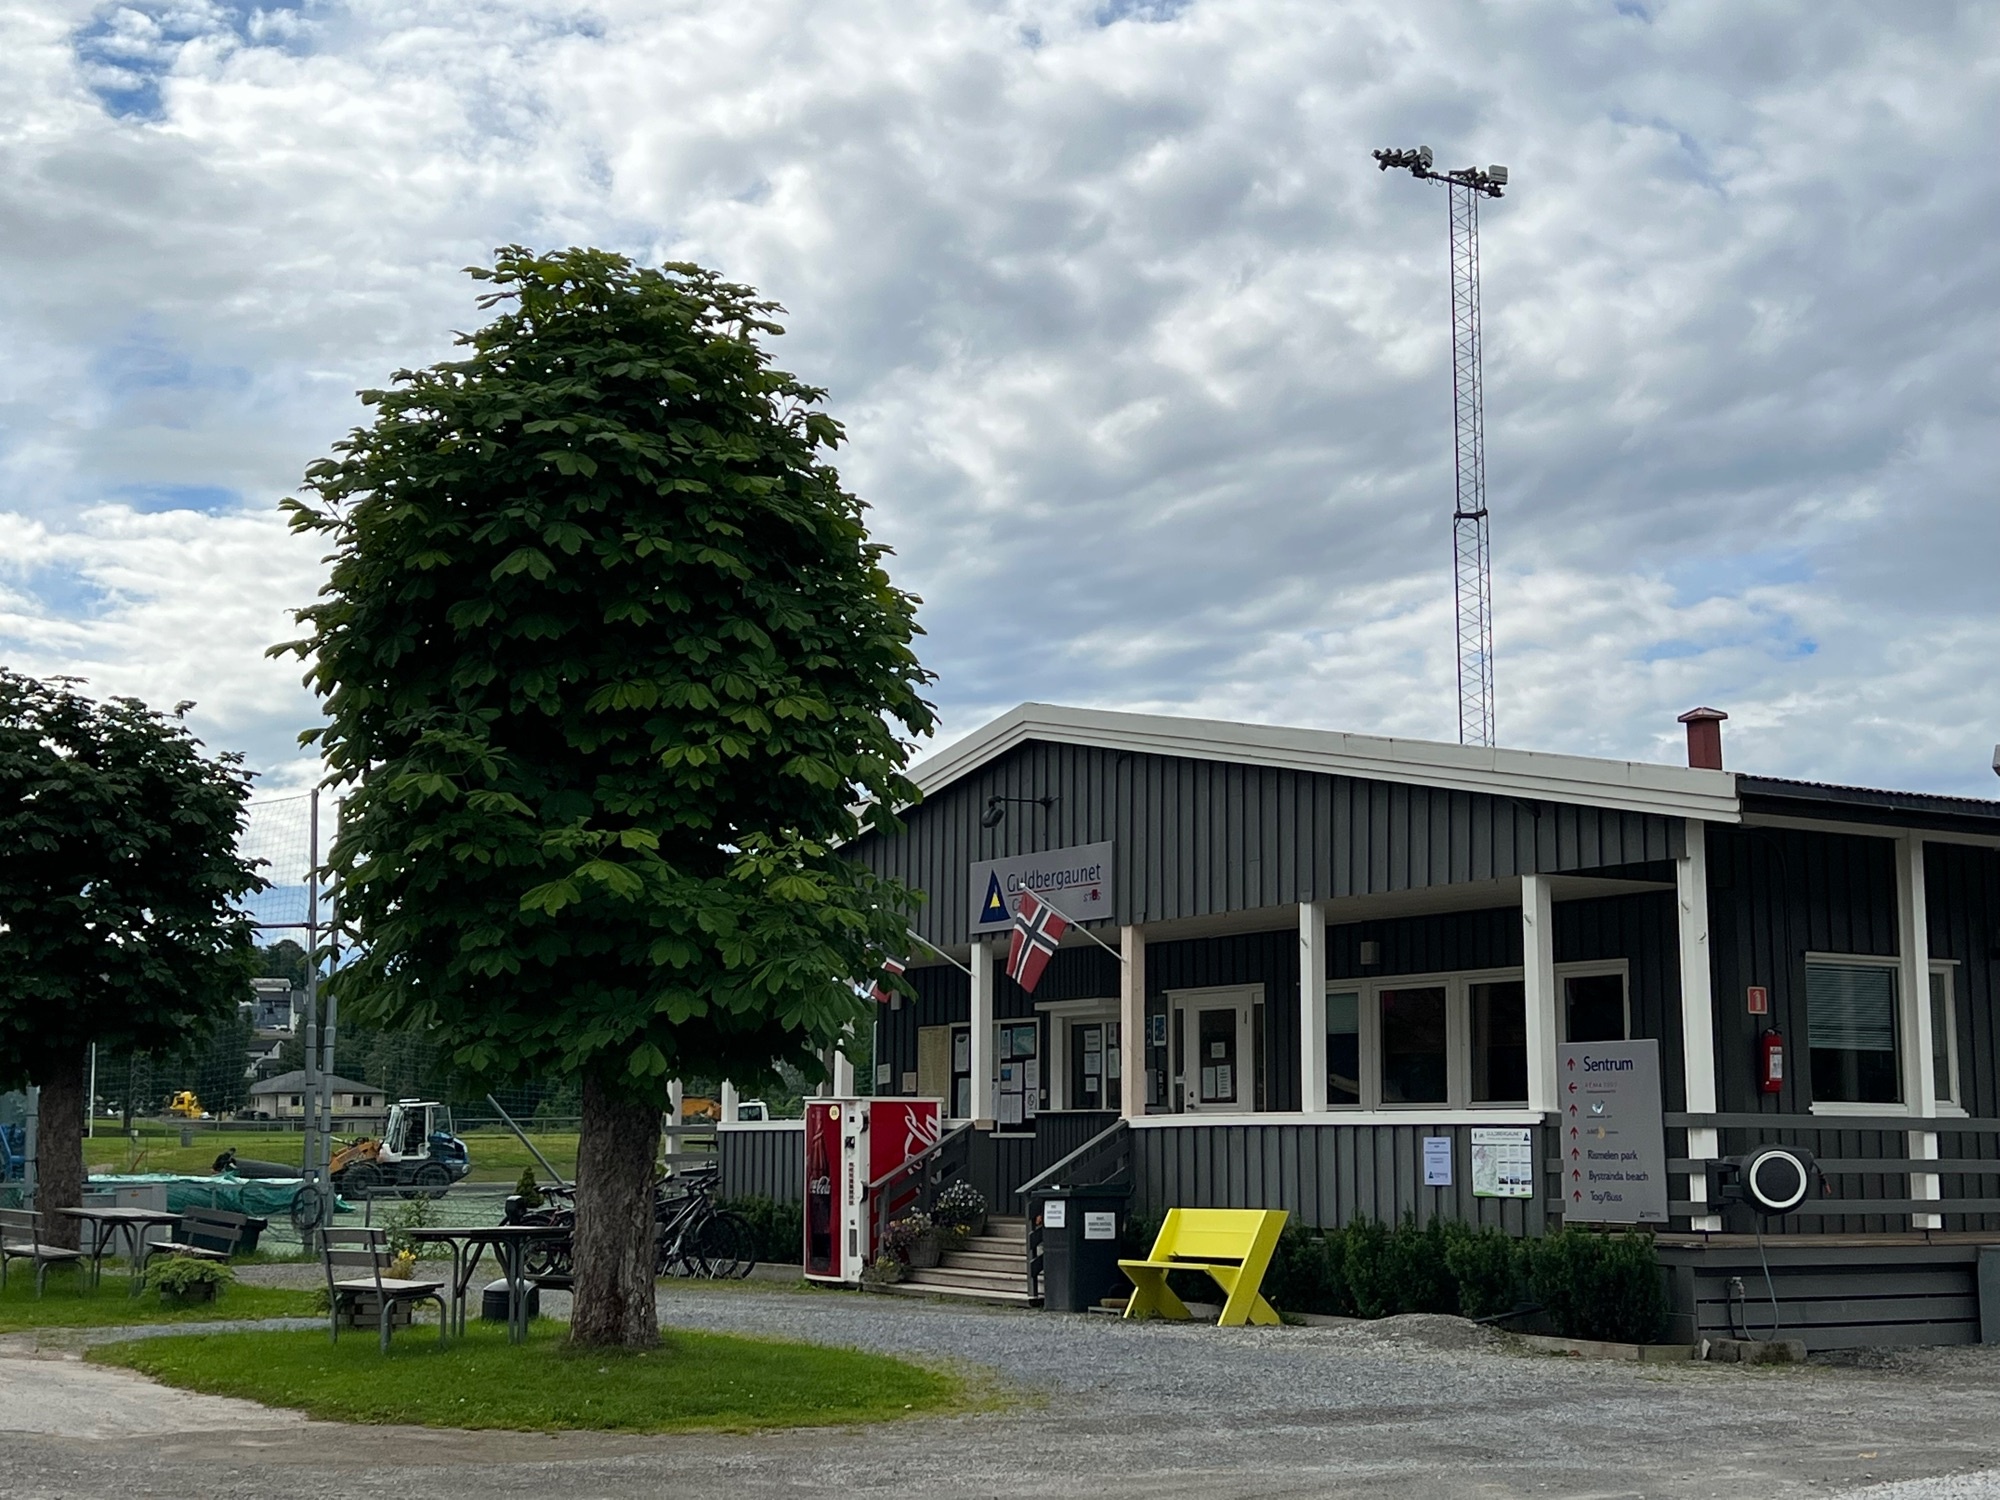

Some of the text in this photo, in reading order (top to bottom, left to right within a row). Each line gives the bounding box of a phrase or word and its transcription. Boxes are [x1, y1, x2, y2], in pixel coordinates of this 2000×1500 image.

[1007, 863, 1101, 893] Guldbergaunet
[1583, 1055, 1634, 1073] Sentrum
[1621, 1149, 1638, 1163] park
[1588, 1170, 1650, 1184] Bystranda beach
